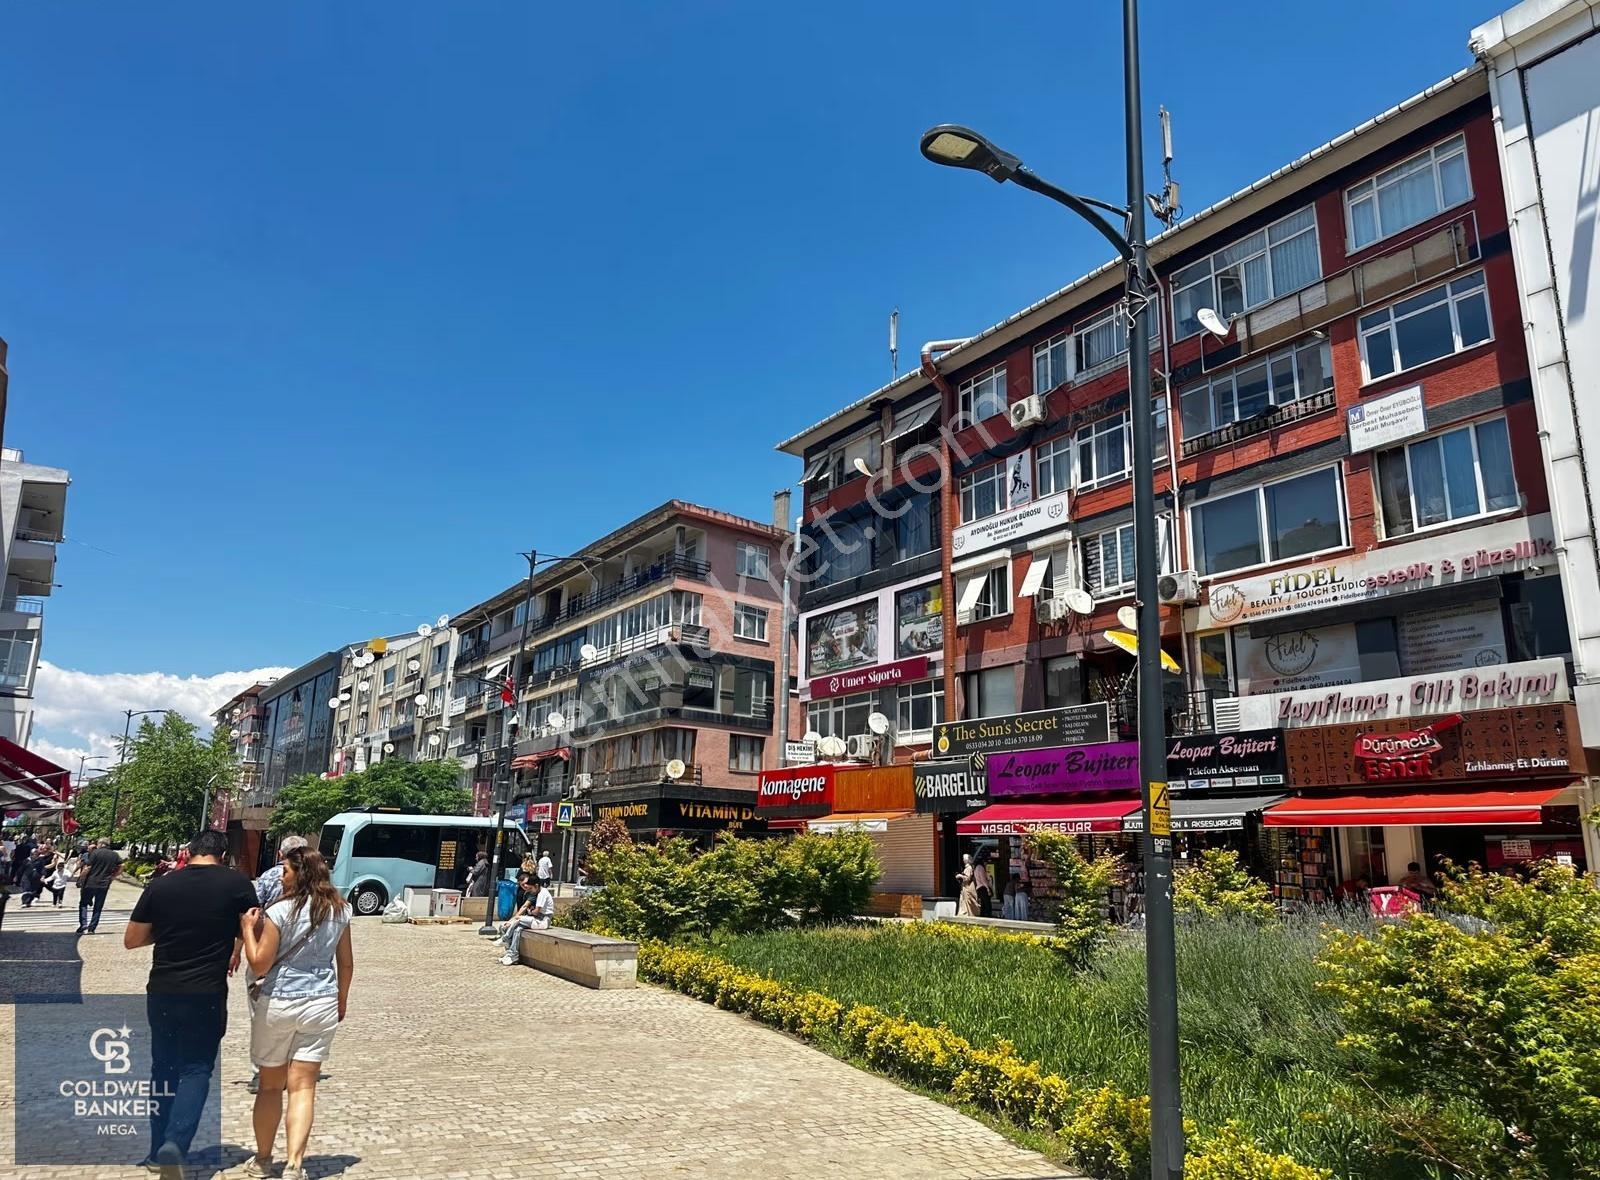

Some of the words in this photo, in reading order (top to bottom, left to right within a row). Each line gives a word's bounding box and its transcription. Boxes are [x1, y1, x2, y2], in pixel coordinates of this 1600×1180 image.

[1351, 418, 1378, 430] Serbest
[1379, 403, 1421, 421] Muhasebeci
[970, 520, 998, 536] AYDINOĞLU
[999, 516, 1018, 527] HUKUK
[1018, 507, 1041, 520] BÜROSU
[1366, 562, 1433, 589] estetik
[1440, 558, 1455, 574] &
[1461, 538, 1553, 574] güzellik
[1268, 565, 1345, 596] FİDEL
[1250, 595, 1283, 609] BEAUTY
[1296, 586, 1328, 600] TOUCH
[1331, 579, 1366, 593] STUDIO
[867, 668, 901, 684] Sigorta
[1278, 692, 1388, 721] Zayıflama
[1410, 680, 1454, 705] Cilt
[1458, 671, 1558, 699] Bakımı
[953, 726, 976, 741] The
[979, 720, 1011, 739] Sun's
[1014, 716, 1058, 734] Secret
[1167, 741, 1215, 762] Leopar
[1219, 736, 1276, 758] Bujiteri
[1362, 733, 1431, 753] Dürümcü
[997, 757, 1060, 778] Leopar
[1187, 766, 1217, 776] Telefon
[1365, 753, 1432, 780] Esnaf
[1465, 760, 1516, 772] Zırhlanmış
[1516, 759, 1528, 768] Et
[1531, 757, 1568, 767] Dürüm
[760, 775, 825, 800] komagene
[599, 804, 624, 818] VİTAMİN
[624, 803, 648, 817] DÖNER
[680, 804, 738, 820] VİTAMİN
[981, 824, 1018, 834] MASAL
